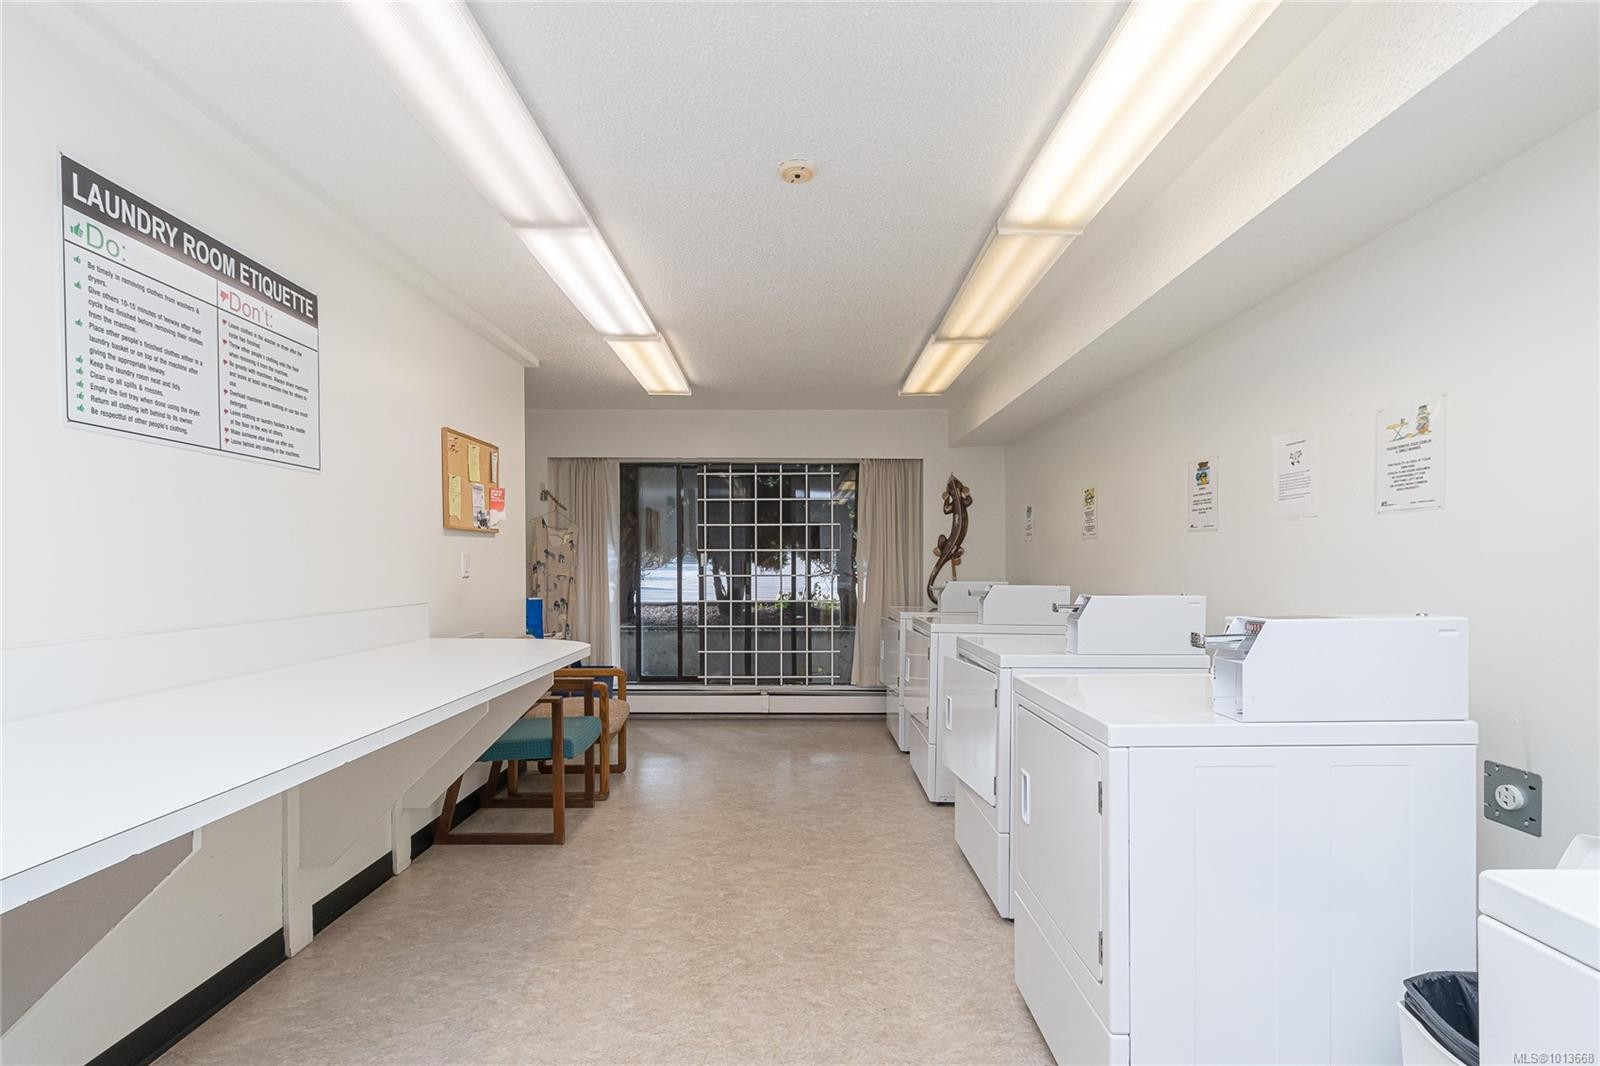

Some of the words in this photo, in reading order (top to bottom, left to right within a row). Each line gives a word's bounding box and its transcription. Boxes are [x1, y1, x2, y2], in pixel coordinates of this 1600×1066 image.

[72, 172, 178, 248] LAUNDRY
[183, 231, 235, 278] ROOM
[240, 262, 314, 319] ETIQUETTE
[86, 222, 126, 263] Do:
[88, 274, 106, 288] dryers.
[88, 261, 95, 271] Be
[97, 265, 112, 279] timely
[121, 277, 144, 292] removing
[146, 287, 163, 299] clothes
[164, 294, 174, 304] from
[177, 300, 194, 312] washers
[88, 285, 100, 296] Give
[102, 292, 118, 303] others
[121, 298, 135, 309] 10-15
[137, 306, 156, 317] minutes
[164, 314, 179, 327] leeway
[192, 325, 201, 334] their
[88, 310, 101, 320] from
[113, 321, 135, 331] machine.
[88, 299, 102, 311] cycle
[104, 304, 113, 313] has
[116, 308, 136, 321] finished
[137, 316, 152, 327] before
[154, 323, 175, 337] removing
[177, 330, 186, 339] their
[188, 336, 202, 345] clothes
[229, 291, 273, 328] Don't:
[89, 322, 104, 333] Place
[106, 329, 119, 338] other
[121, 334, 142, 347] people's
[144, 340, 162, 352] finished
[164, 348, 179, 357] clothes
[181, 354, 193, 362] either
[89, 334, 109, 348] laundry
[111, 342, 128, 352] basket
[168, 361, 186, 370] machine
[89, 348, 106, 359] giving
[117, 356, 146, 370] appropriate
[148, 364, 164, 376] leeway.
[90, 359, 103, 370] Keep
[105, 363, 113, 371] the
[115, 366, 134, 378] laundry
[172, 382, 180, 391] tidy.
[90, 370, 105, 380] Clean
[107, 376, 114, 384] up
[124, 381, 136, 390] spills
[144, 386, 163, 395] messes.
[90, 383, 107, 395] Empty
[128, 392, 138, 402] tray
[154, 398, 165, 407] done
[167, 403, 179, 412] using
[188, 407, 200, 416] dryer.
[90, 395, 108, 405] Return
[119, 403, 138, 413] clothing
[150, 408, 165, 418] behind
[91, 407, 98, 415] Be
[100, 410, 126, 422] respectful
[148, 420, 168, 430] people's
[169, 425, 187, 434] clothing.
